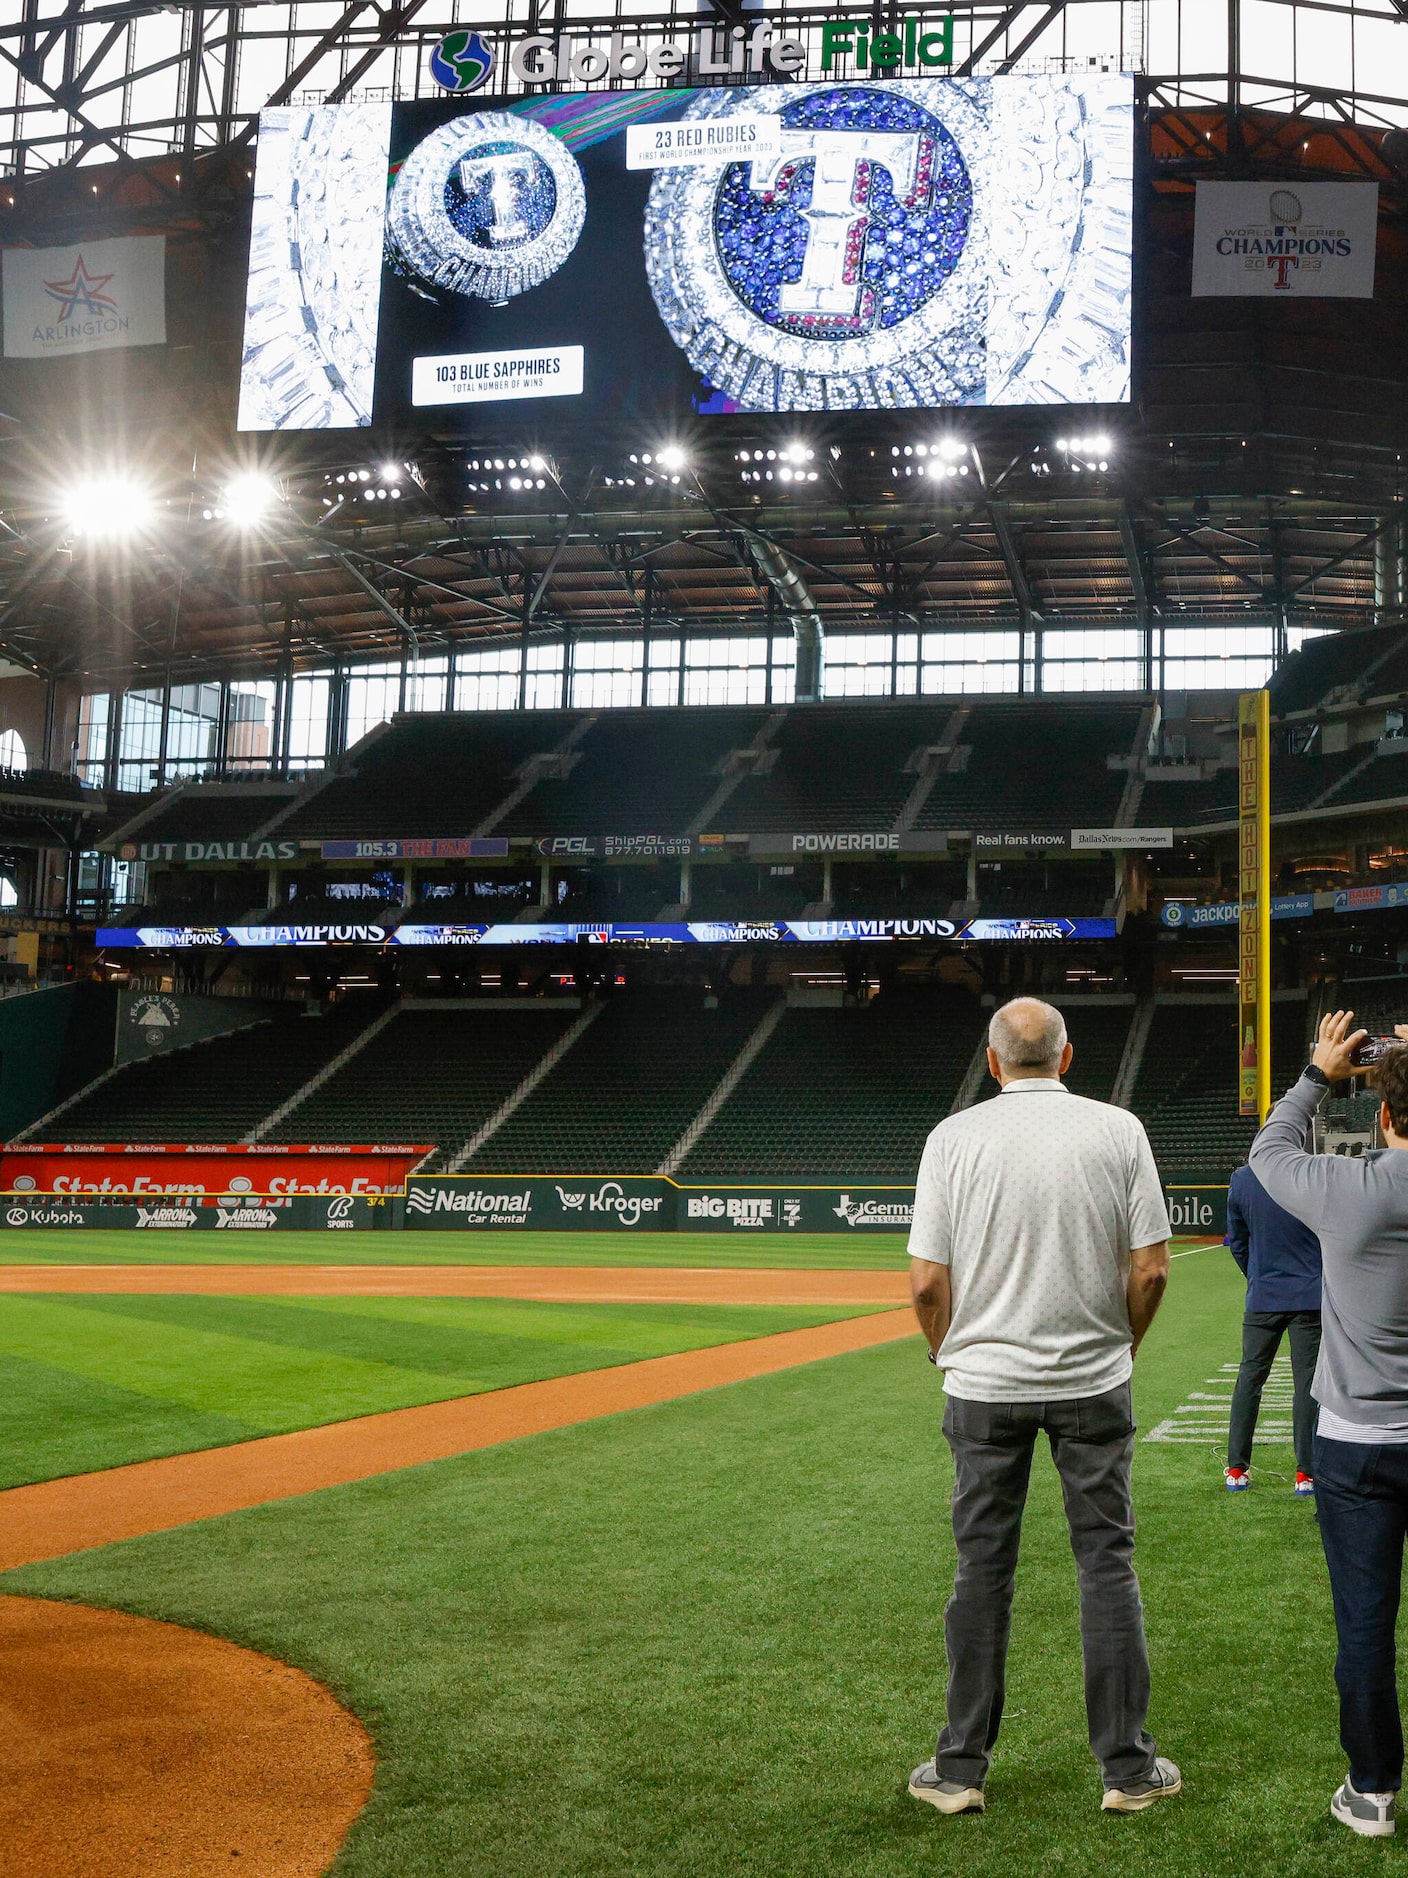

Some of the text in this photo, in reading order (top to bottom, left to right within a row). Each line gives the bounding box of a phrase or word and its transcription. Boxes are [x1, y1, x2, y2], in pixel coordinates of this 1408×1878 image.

[512, 16, 955, 83] Globe Life Field
[655, 124, 757, 149] 23 RED RUBIES
[638, 142, 773, 160] FIRST WORLD CHAMPIONSHIP YEAR 2023
[460, 152, 536, 242] T
[748, 128, 937, 329] T
[1224, 229, 1346, 237] WORLD SERIES
[1216, 237, 1352, 256] CHAMPIONS
[1244, 256, 1322, 289] 20 T 23
[32, 317, 129, 342] ARLINGTON
[436, 357, 560, 382] 103 BLUE SAPPHIRES
[453, 378, 543, 393] TOTAL NUMBER OF WINS
[1243, 737, 1255, 805] THE
[552, 837, 595, 852] PGL
[605, 835, 691, 846] ShipPGL.com
[792, 833, 900, 851] POWERADE
[976, 833, 1065, 845] Real fans know.
[140, 841, 295, 861] UT DALLAS
[355, 840, 472, 857] 105.3 THE FAN
[604, 846, 691, 856] 877.701.1919
[1243, 822, 1255, 893] HOT
[1349, 887, 1382, 899] BAKER
[242, 925, 386, 941] CHAMPIONS
[701, 928, 779, 941] CHAMPIONS
[802, 920, 955, 936] CHAMPIONS
[984, 928, 1063, 940] CHAMPIONS
[150, 932, 223, 946] CHAMPIONS
[408, 934, 481, 945] CHAMPIONS
[1243, 910, 1255, 1003] ZONE
[366, 1197, 386, 1207] 374
[589, 1182, 663, 1226] Kroger
[727, 1199, 773, 1217] BITE
[864, 1201, 914, 1216] Germa
[31, 1210, 84, 1225] Kubota
[150, 1208, 187, 1221] ARROW
[231, 1208, 268, 1222] ARROW
[468, 1213, 527, 1224] Car Rental
[1167, 1196, 1213, 1226] bile
[327, 1220, 354, 1229] SPORTS
[734, 1217, 765, 1227] PIZZA
